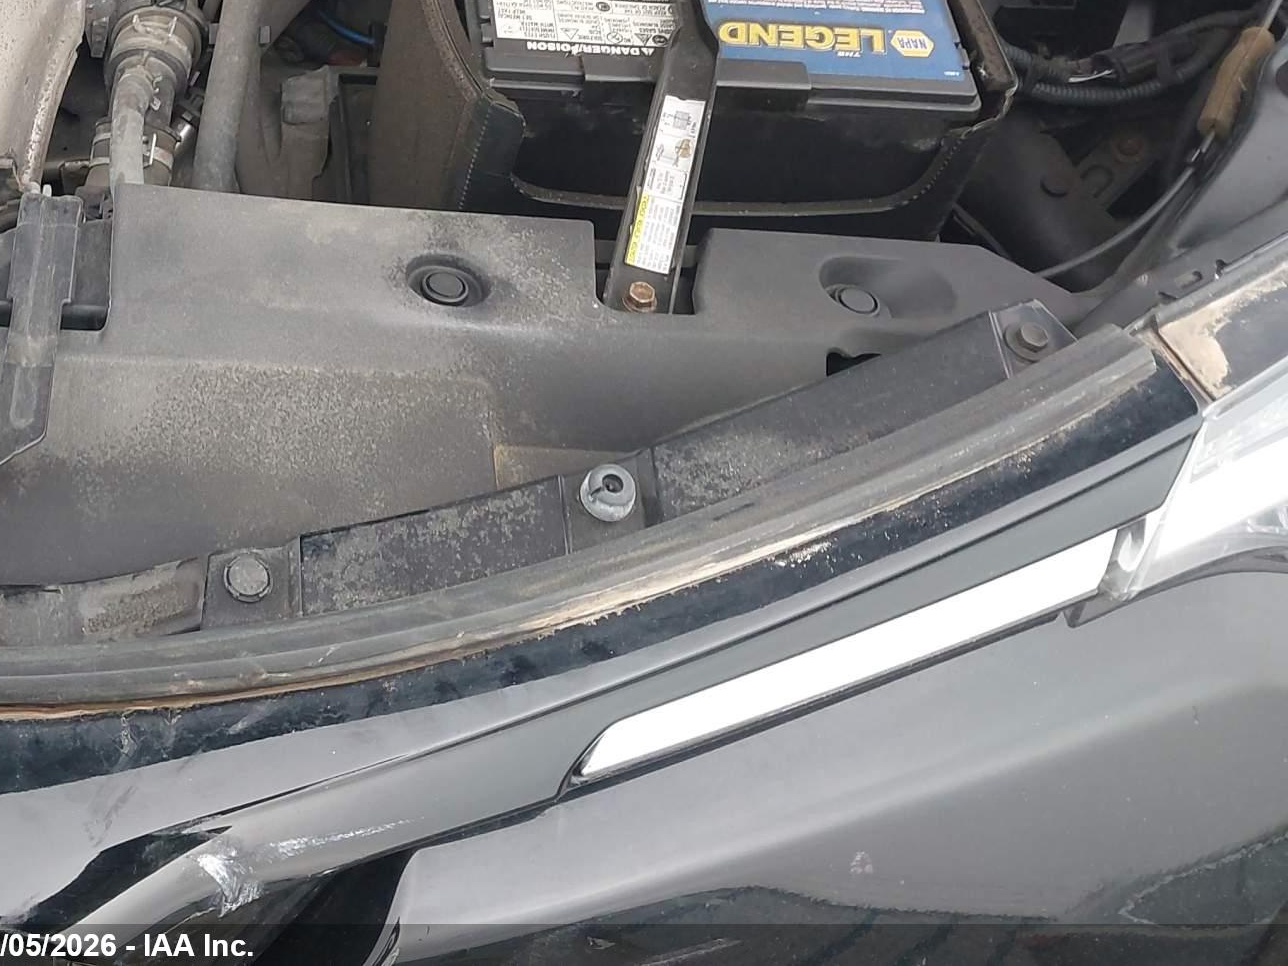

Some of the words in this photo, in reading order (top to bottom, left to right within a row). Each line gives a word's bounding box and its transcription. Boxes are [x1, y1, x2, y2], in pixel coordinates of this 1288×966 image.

[718, 21, 885, 54] LEGEND
[897, 37, 926, 50] NAPA
[526, 41, 640, 56] DANGER/POISON
